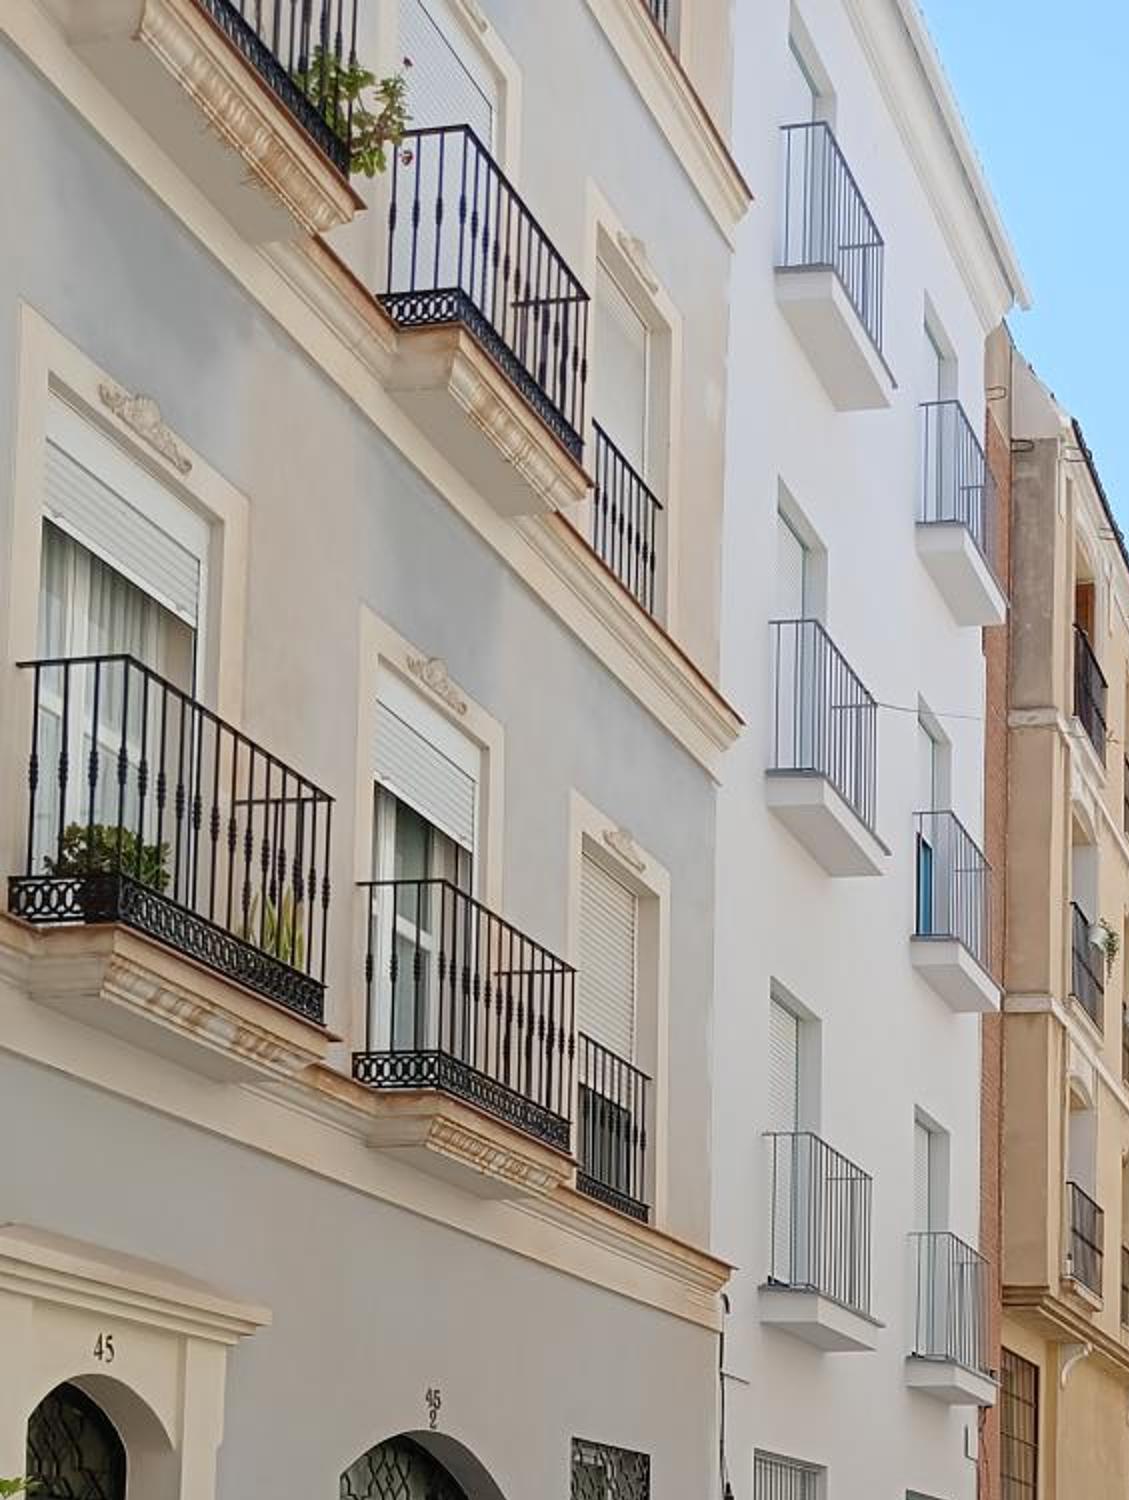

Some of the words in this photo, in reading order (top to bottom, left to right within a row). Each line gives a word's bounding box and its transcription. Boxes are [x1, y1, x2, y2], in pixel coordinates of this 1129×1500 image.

[93, 1332, 115, 1363] 45
[425, 1387, 441, 1409] 45
[429, 1409, 437, 1429] 2
